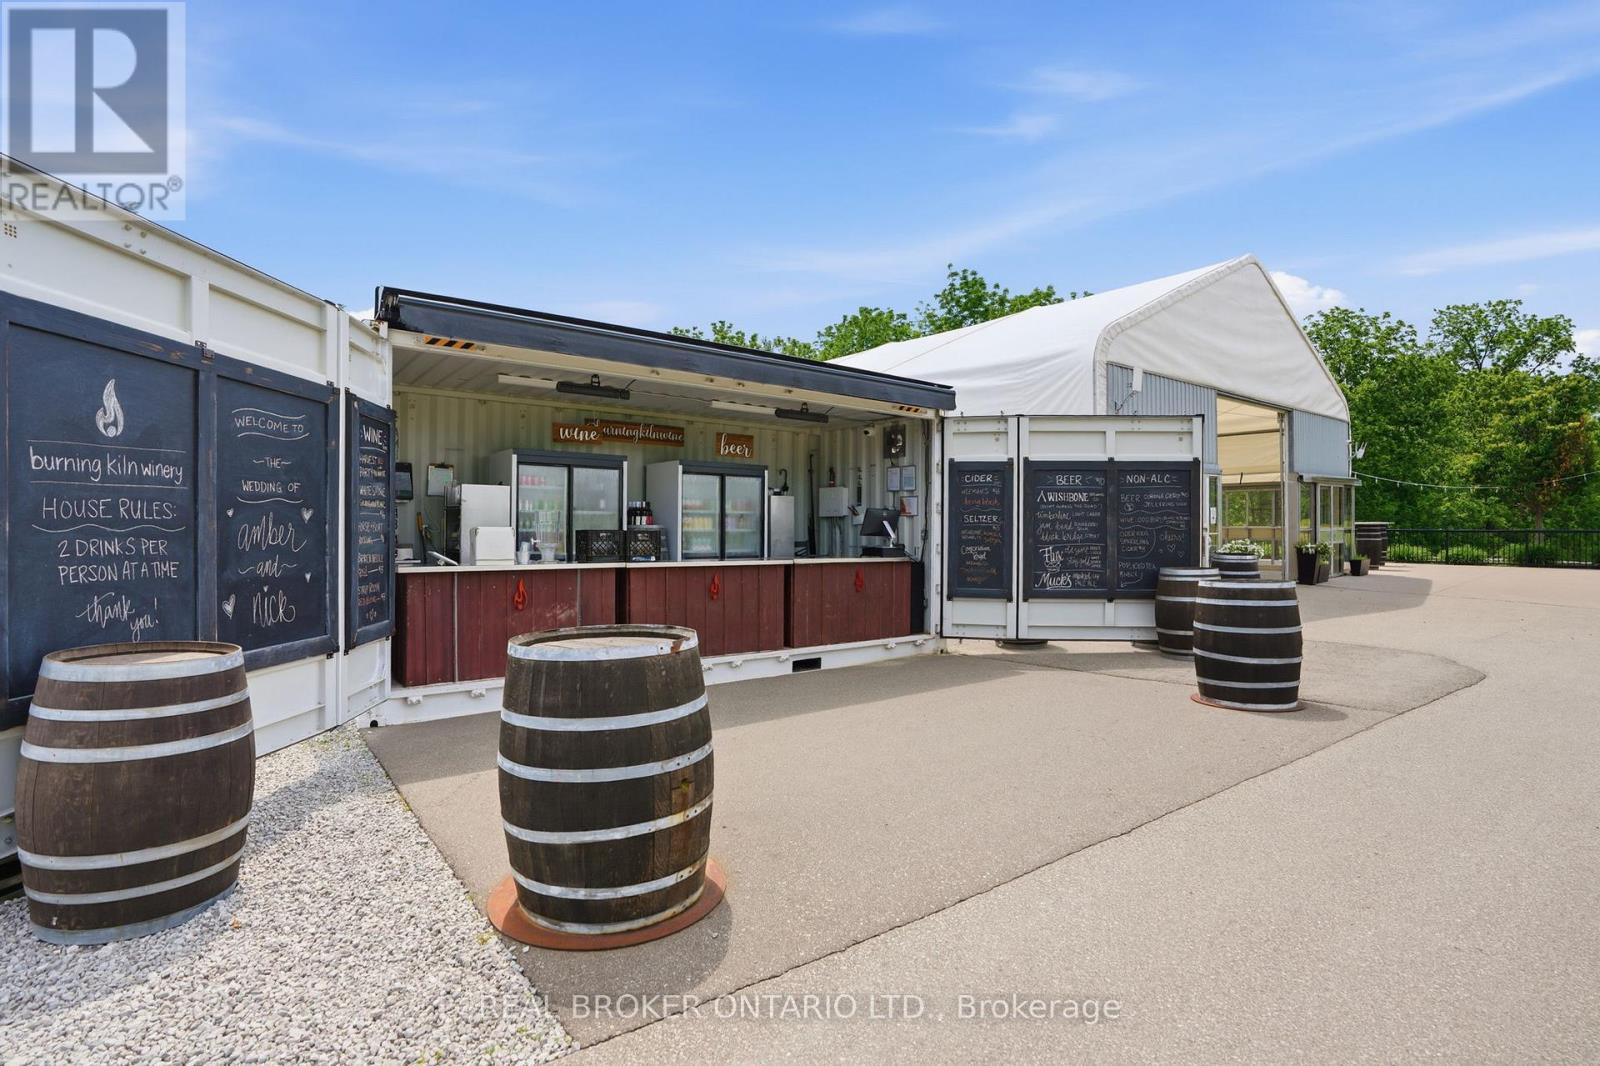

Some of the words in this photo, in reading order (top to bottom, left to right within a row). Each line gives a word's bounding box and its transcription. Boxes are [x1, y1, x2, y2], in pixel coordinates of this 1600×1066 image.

[234, 416, 289, 432] WELCOME
[291, 423, 304, 434] TO
[362, 424, 383, 446] WINE
[559, 427, 600, 442] wine
[720, 433, 752, 458] beer
[29, 446, 102, 482] burning
[106, 452, 138, 476] kiln
[141, 456, 183, 486] winery
[265, 457, 282, 469] THE
[242, 480, 283, 494] WEDDING
[286, 482, 301, 493] OF
[964, 474, 993, 483] CIDER
[1056, 474, 1082, 485] BEER
[1047, 491, 1089, 502] WISHBONE
[42, 498, 112, 521] HOUSE
[119, 499, 178, 521] RULES:
[963, 514, 999, 523] SELTZER
[58, 541, 69, 558] 2
[75, 538, 137, 558] DRINKS
[141, 539, 169, 556] PER
[59, 562, 118, 586] PERSON
[122, 560, 139, 580] AT
[141, 562, 149, 578] A
[150, 561, 180, 578] TIME
[75, 592, 135, 629] thank
